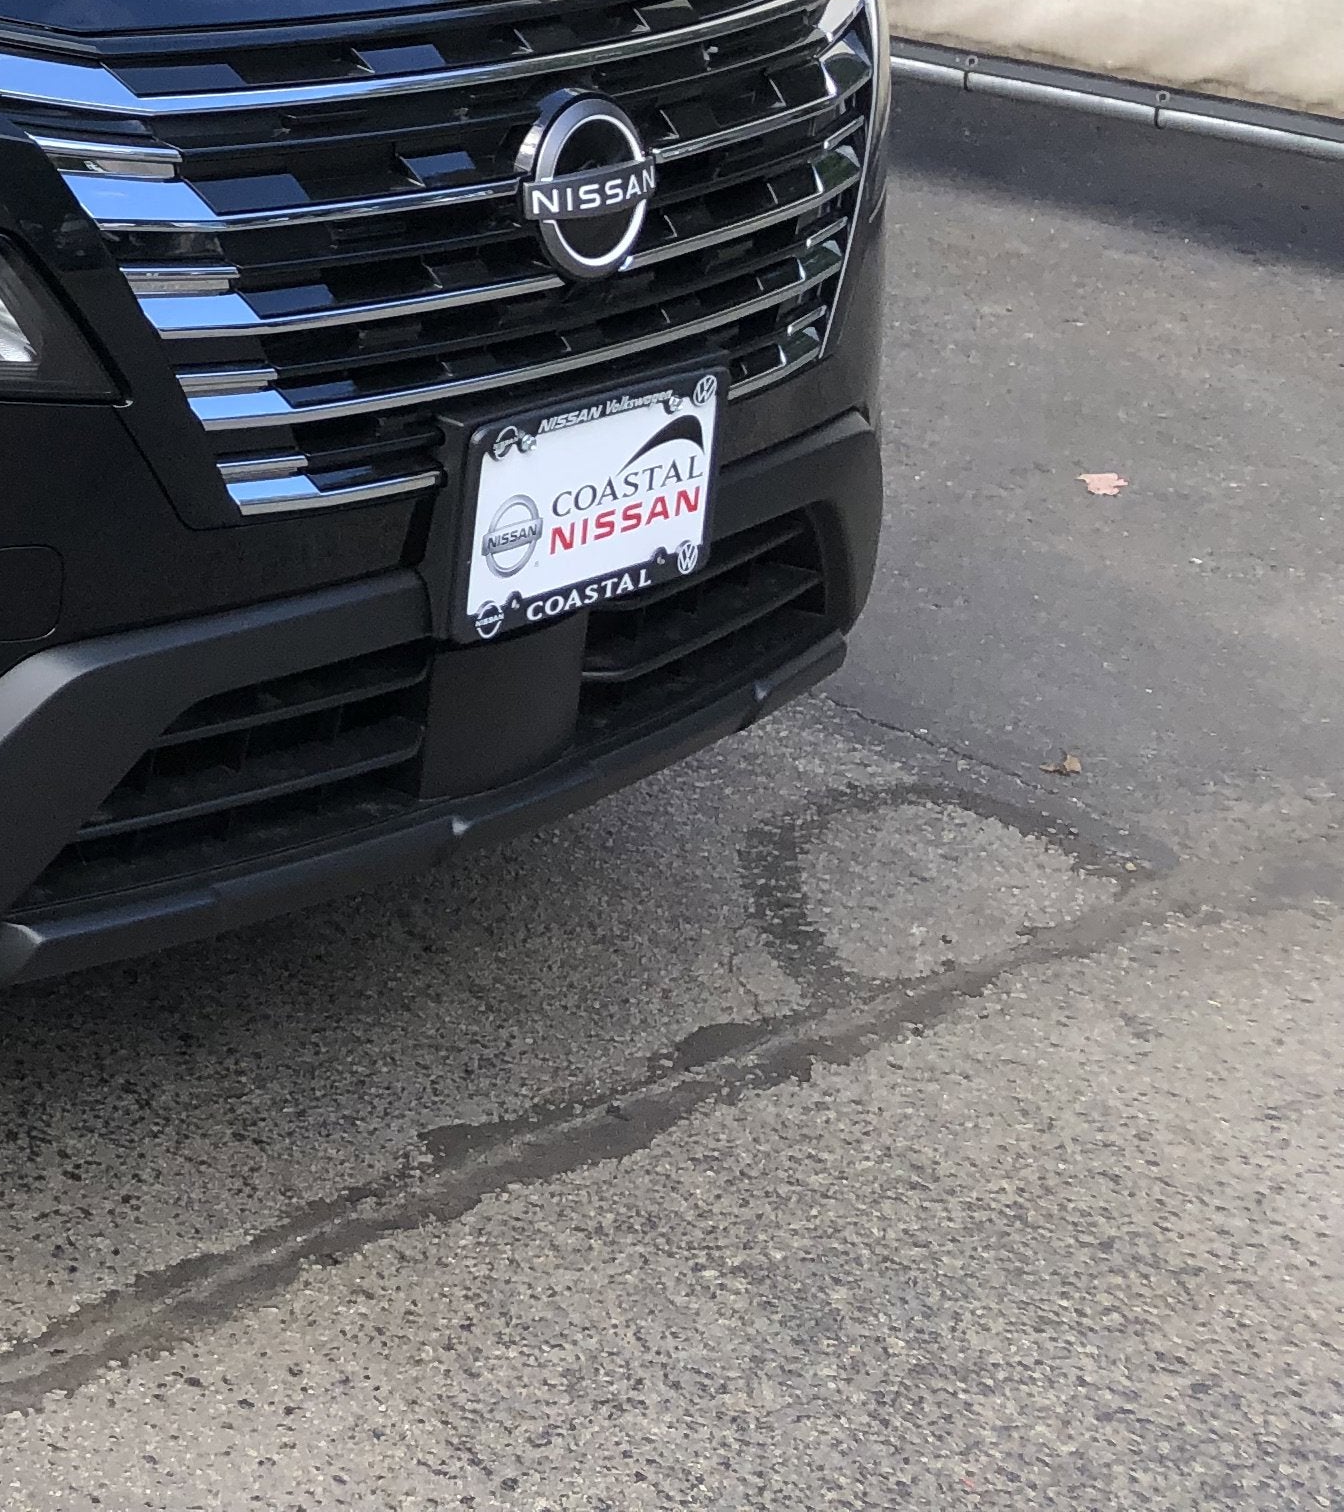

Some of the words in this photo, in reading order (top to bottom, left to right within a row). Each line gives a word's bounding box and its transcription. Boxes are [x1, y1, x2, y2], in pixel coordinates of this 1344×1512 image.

[531, 165, 656, 215] NISSAN
[538, 405, 603, 434] NISSAN
[606, 389, 674, 416] Volkswagen
[552, 455, 704, 518] COASTAL
[486, 522, 538, 550] NISSAN
[548, 485, 702, 556] NISSAN
[526, 568, 652, 622] COASTAL
